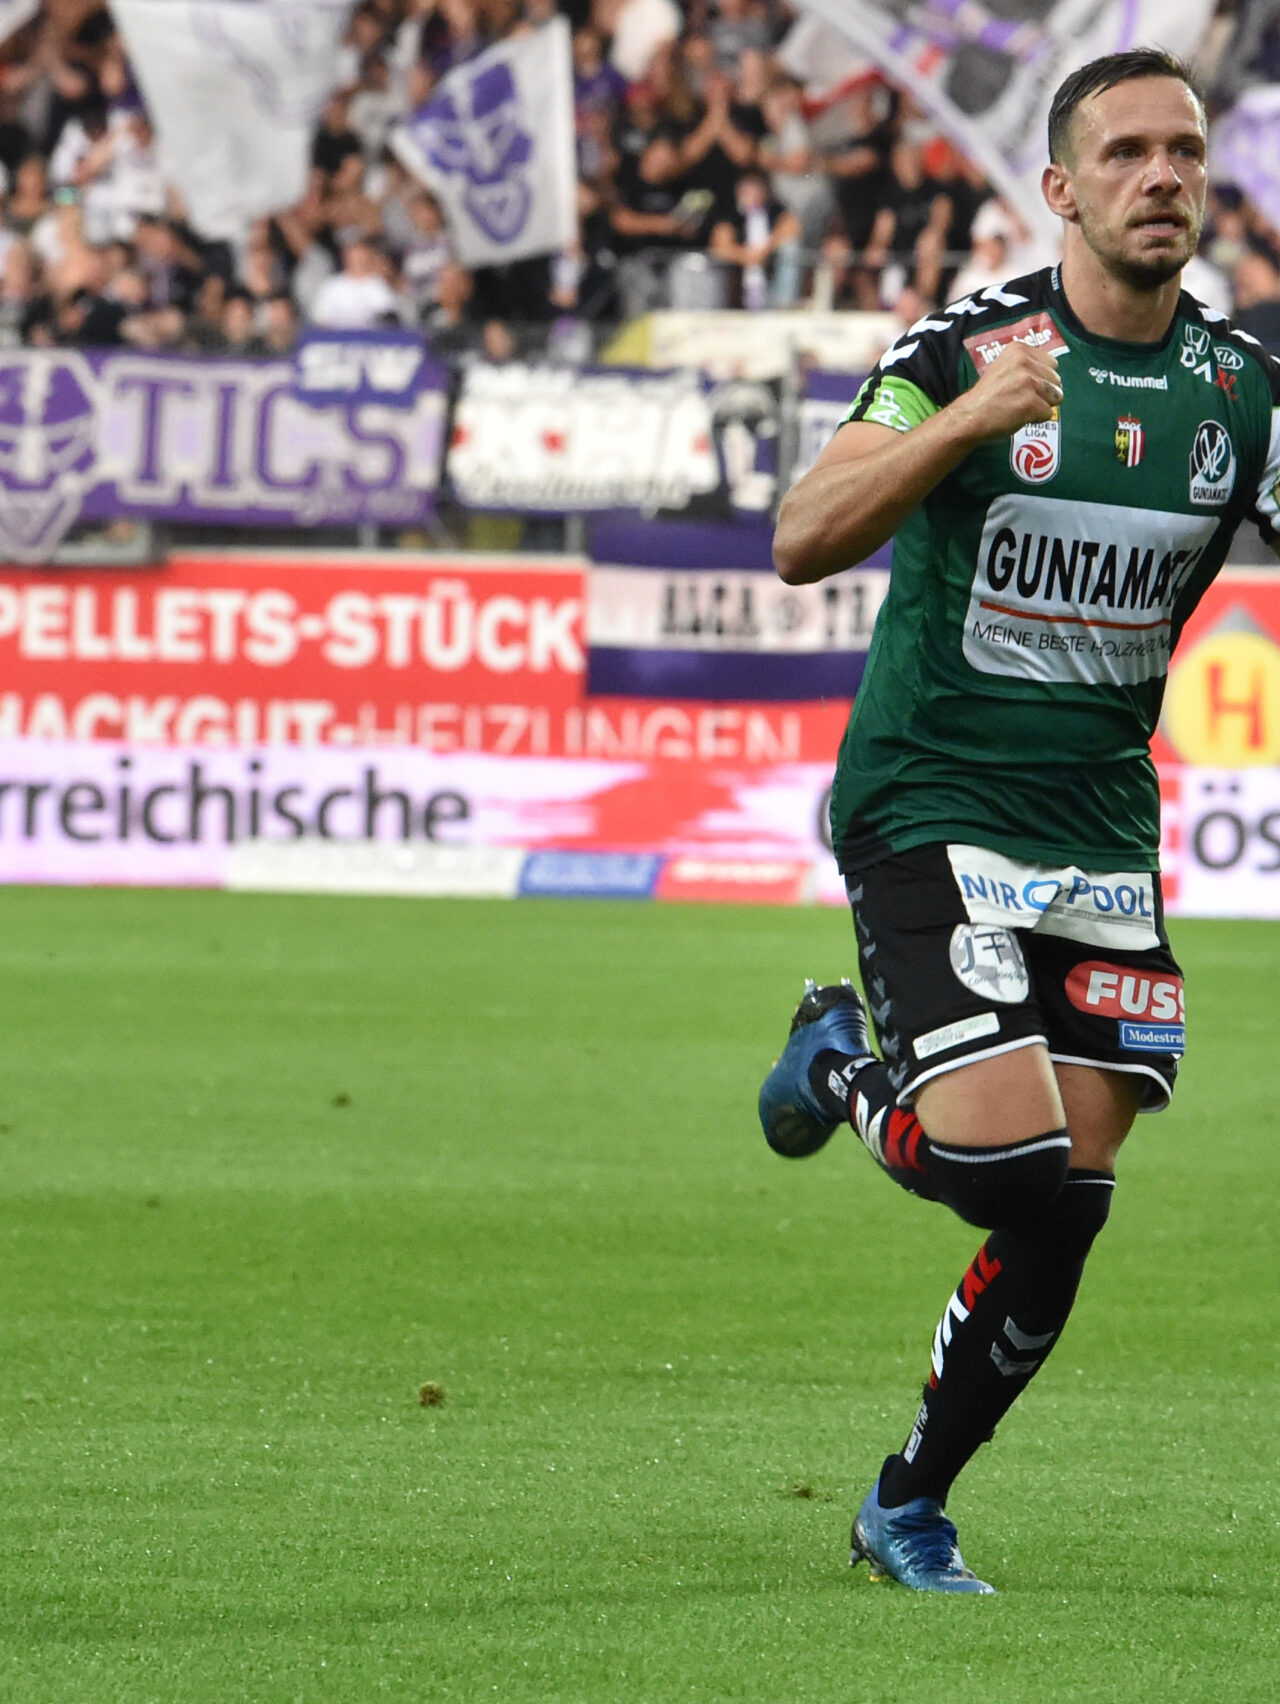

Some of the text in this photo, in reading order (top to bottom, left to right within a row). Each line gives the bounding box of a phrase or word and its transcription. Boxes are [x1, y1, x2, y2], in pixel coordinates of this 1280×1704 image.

[1109, 371, 1168, 390] hummel
[1025, 430, 1048, 438] LIGA
[972, 621, 1034, 648] MEINE
[1038, 633, 1086, 653] BESTE
